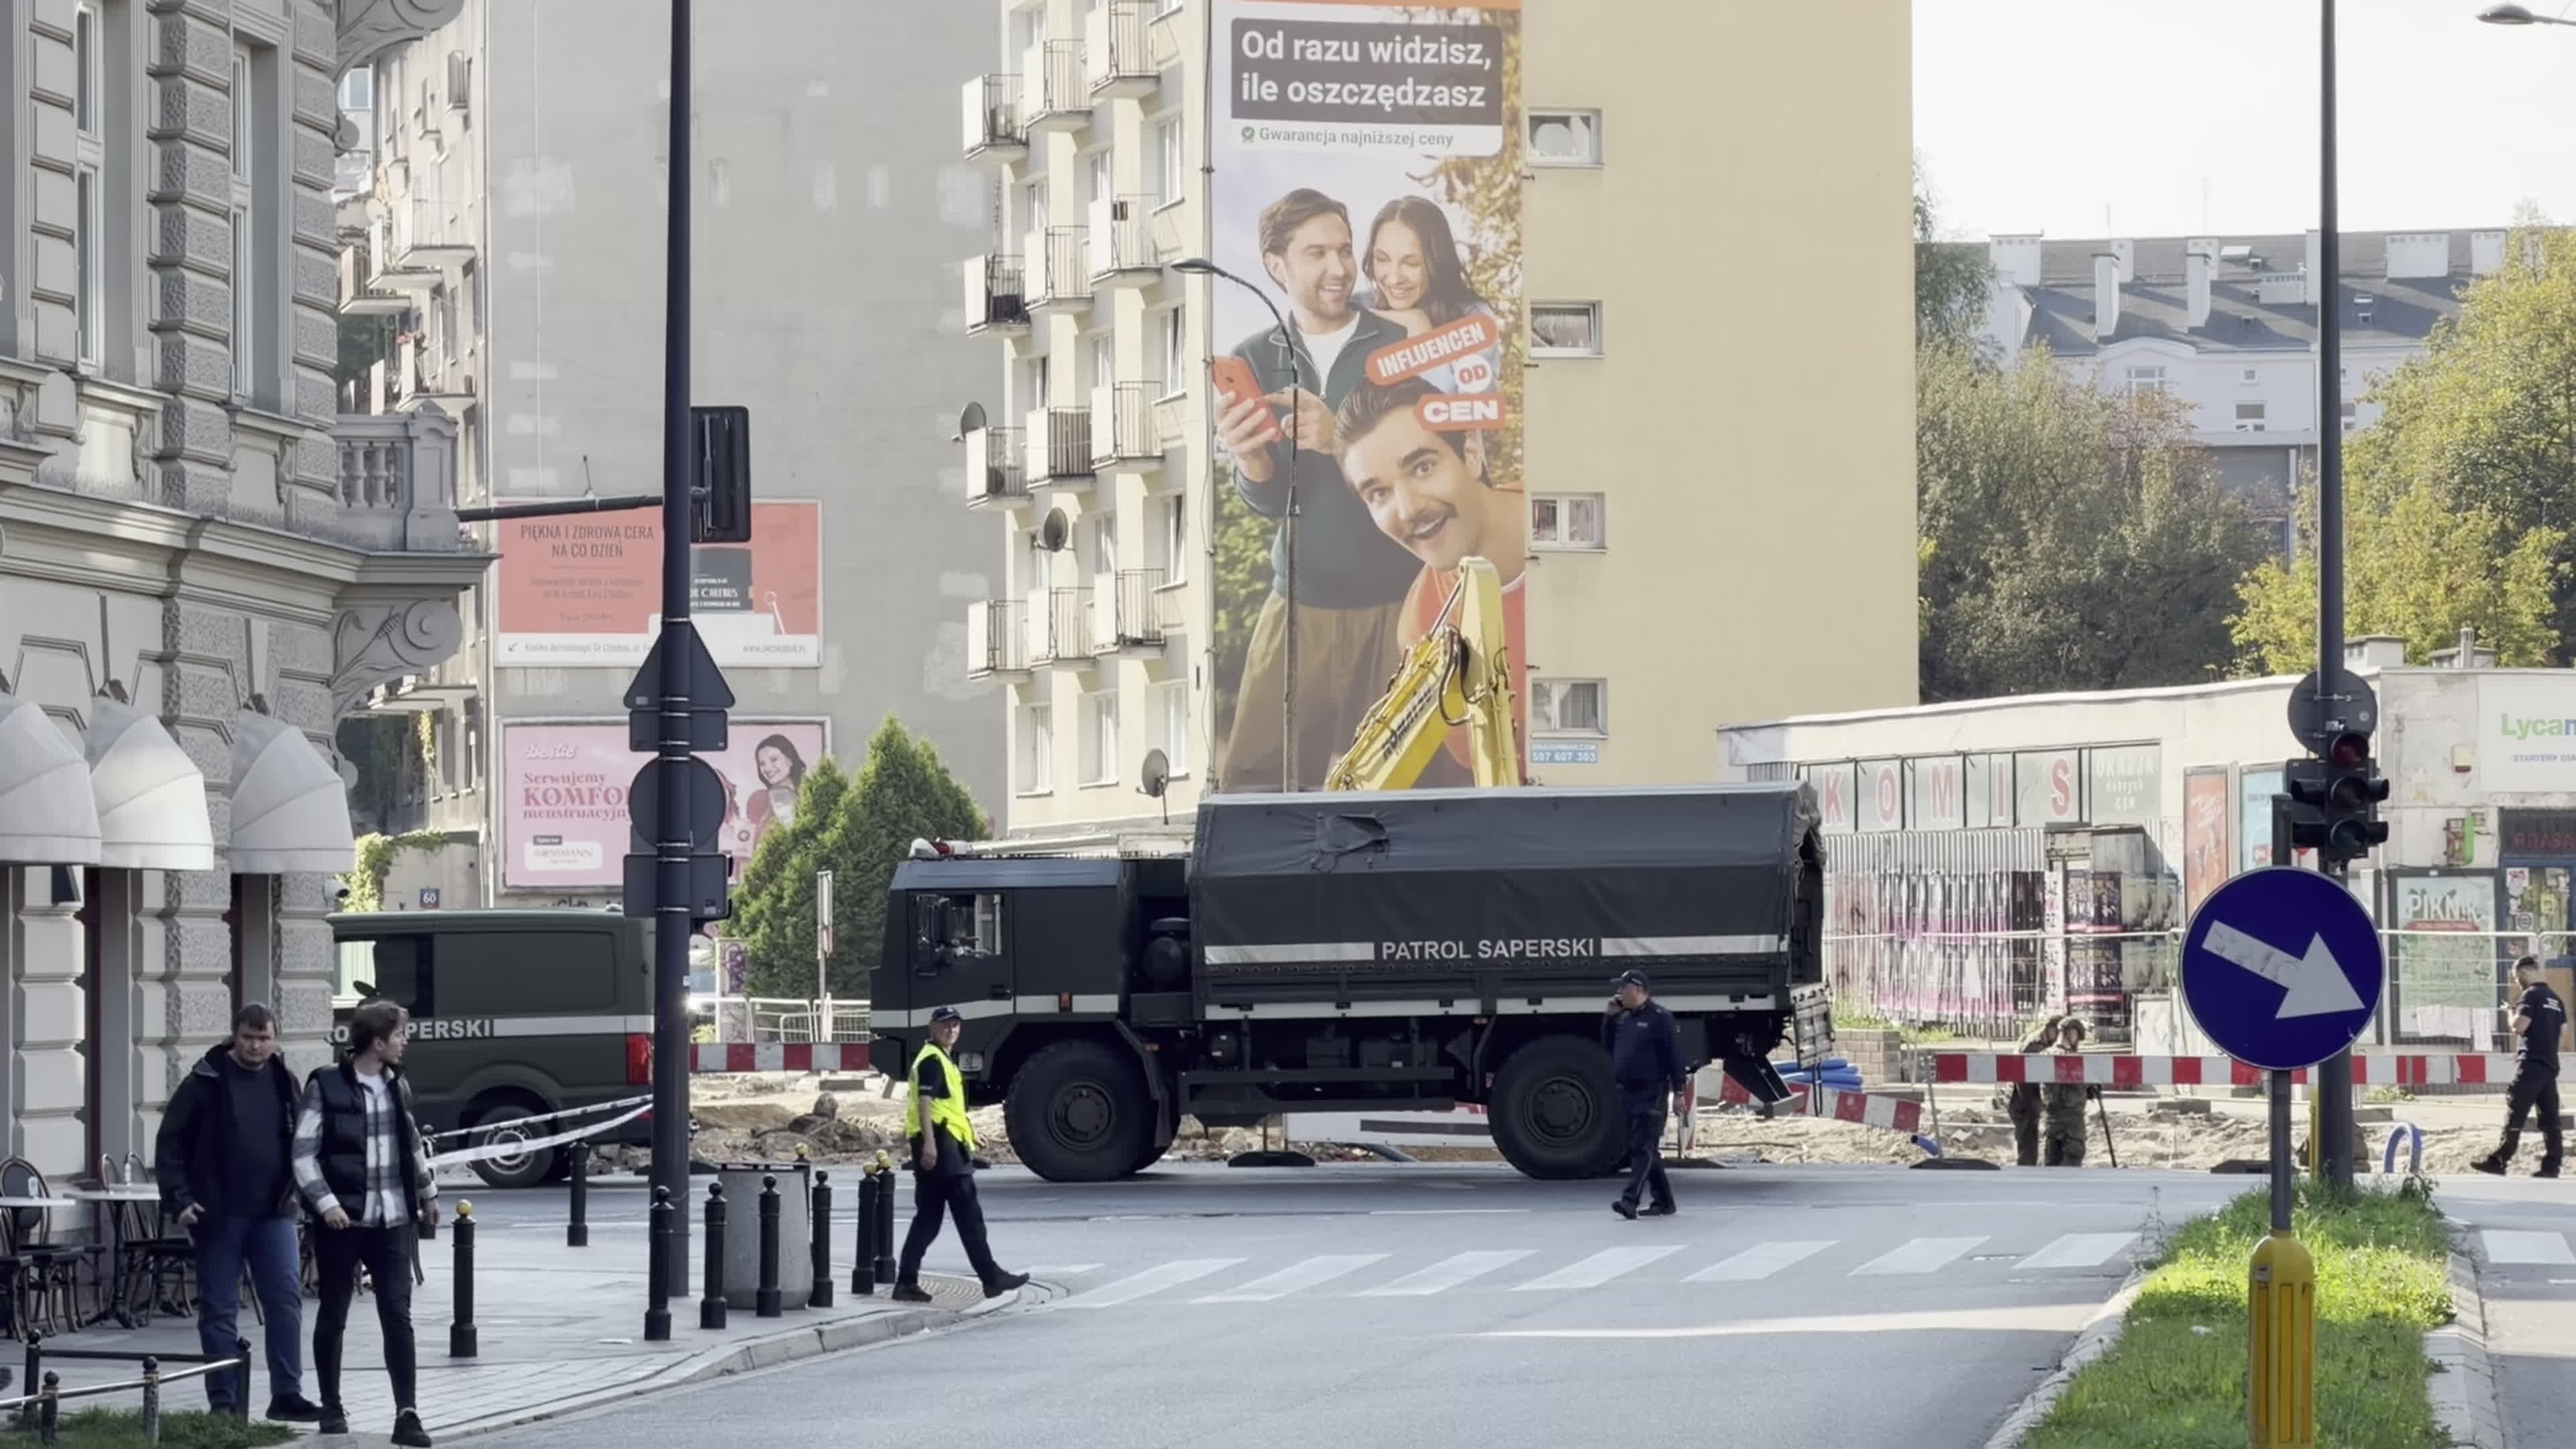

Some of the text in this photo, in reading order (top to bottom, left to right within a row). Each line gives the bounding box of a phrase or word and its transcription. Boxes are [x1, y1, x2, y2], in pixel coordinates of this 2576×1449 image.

[1242, 30, 1491, 70] Od razu widzisz,
[1242, 72, 1487, 112] ile oszczędzasz
[1259, 127, 1454, 148] Gwarancja najniższej ceny
[1377, 321, 1487, 378] INFLUENCEN
[1459, 364, 1487, 384] OD
[1423, 400, 1499, 423] CEN
[521, 525, 654, 542] PIĘKNA I ZDROWA CERA
[552, 542, 623, 558] NA CO DZIEŃ
[523, 772, 606, 786] Serwujemy
[523, 787, 629, 806] KOMFO
[423, 892, 436, 904] 60
[1381, 938, 1595, 961] PATROL SAPERSKI
